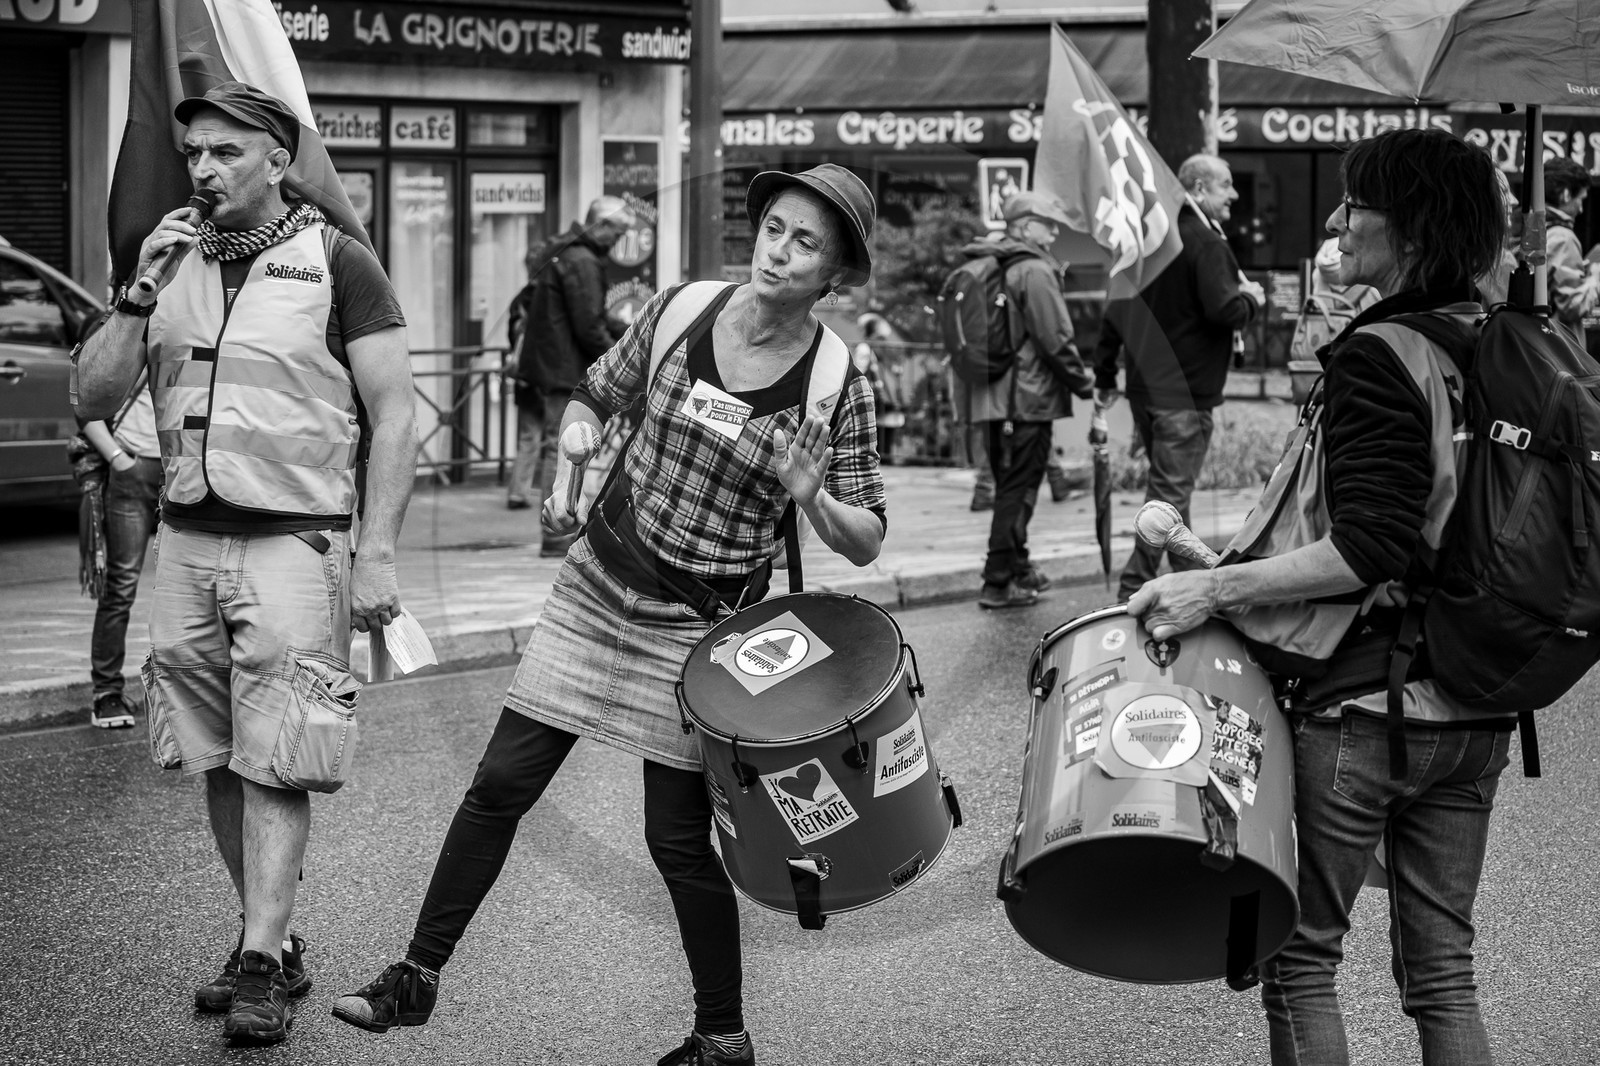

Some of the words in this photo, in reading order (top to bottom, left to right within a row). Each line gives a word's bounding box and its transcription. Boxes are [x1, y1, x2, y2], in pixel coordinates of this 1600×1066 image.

[354, 8, 392, 45] LA
[402, 13, 602, 59] GRIGNOTERIE
[395, 115, 451, 139] café
[837, 110, 983, 149] Crêperie
[265, 262, 323, 284] Solidaires
[710, 411, 727, 421] pour
[737, 405, 751, 415] voix
[741, 649, 778, 673] Solidaires
[1125, 708, 1186, 724] Solidaires
[893, 728, 916, 750] Solidaires
[1128, 732, 1186, 743] Antifasciste
[880, 746, 924, 780] Antifasciste
[777, 797, 804, 819] MA
[1112, 813, 1161, 828] Solidaires
[1044, 823, 1083, 845] Solidaires
